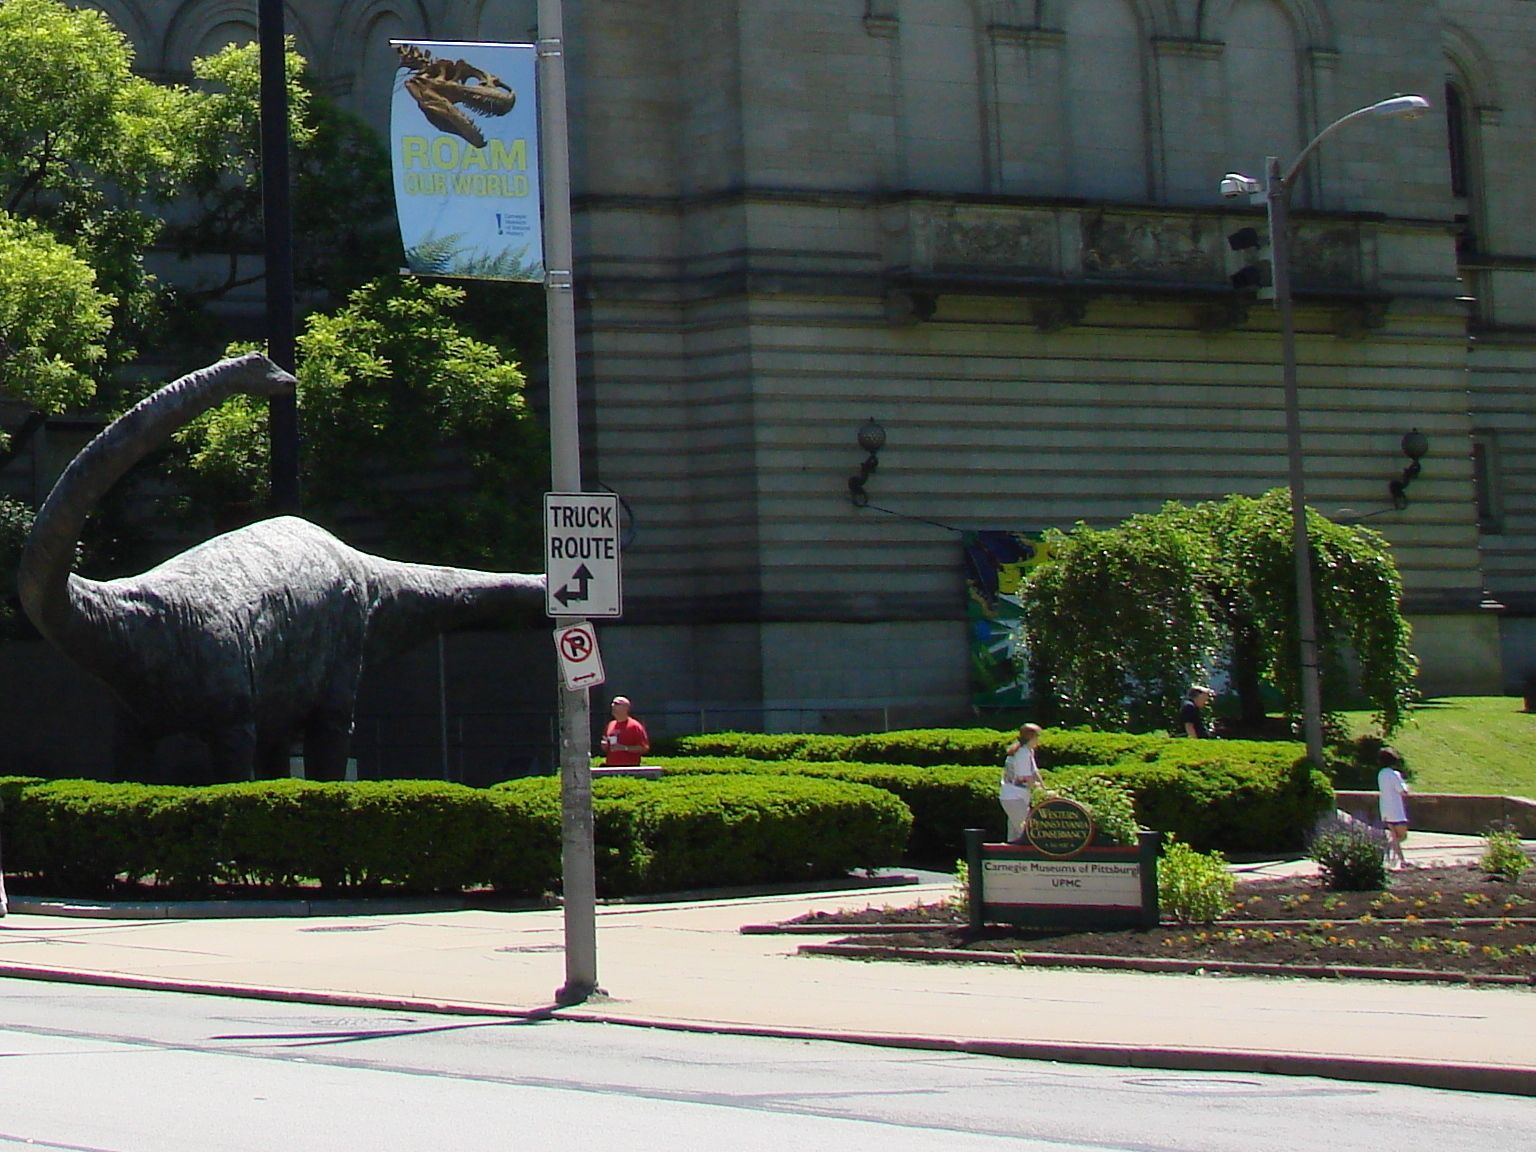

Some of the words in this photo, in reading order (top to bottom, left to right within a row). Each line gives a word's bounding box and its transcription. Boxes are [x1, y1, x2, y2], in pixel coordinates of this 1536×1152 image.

[401, 135, 528, 170] ROAM
[405, 172, 448, 196] OUR
[453, 173, 529, 198] WORLD
[550, 506, 612, 528] TRUCK
[551, 536, 614, 559] ROUTE
[984, 862, 1027, 873] Carnegie
[1030, 863, 1076, 873] Museums
[1078, 863, 1089, 873] of
[1091, 864, 1139, 877] Pittsburg
[1051, 879, 1083, 888] UPMC
